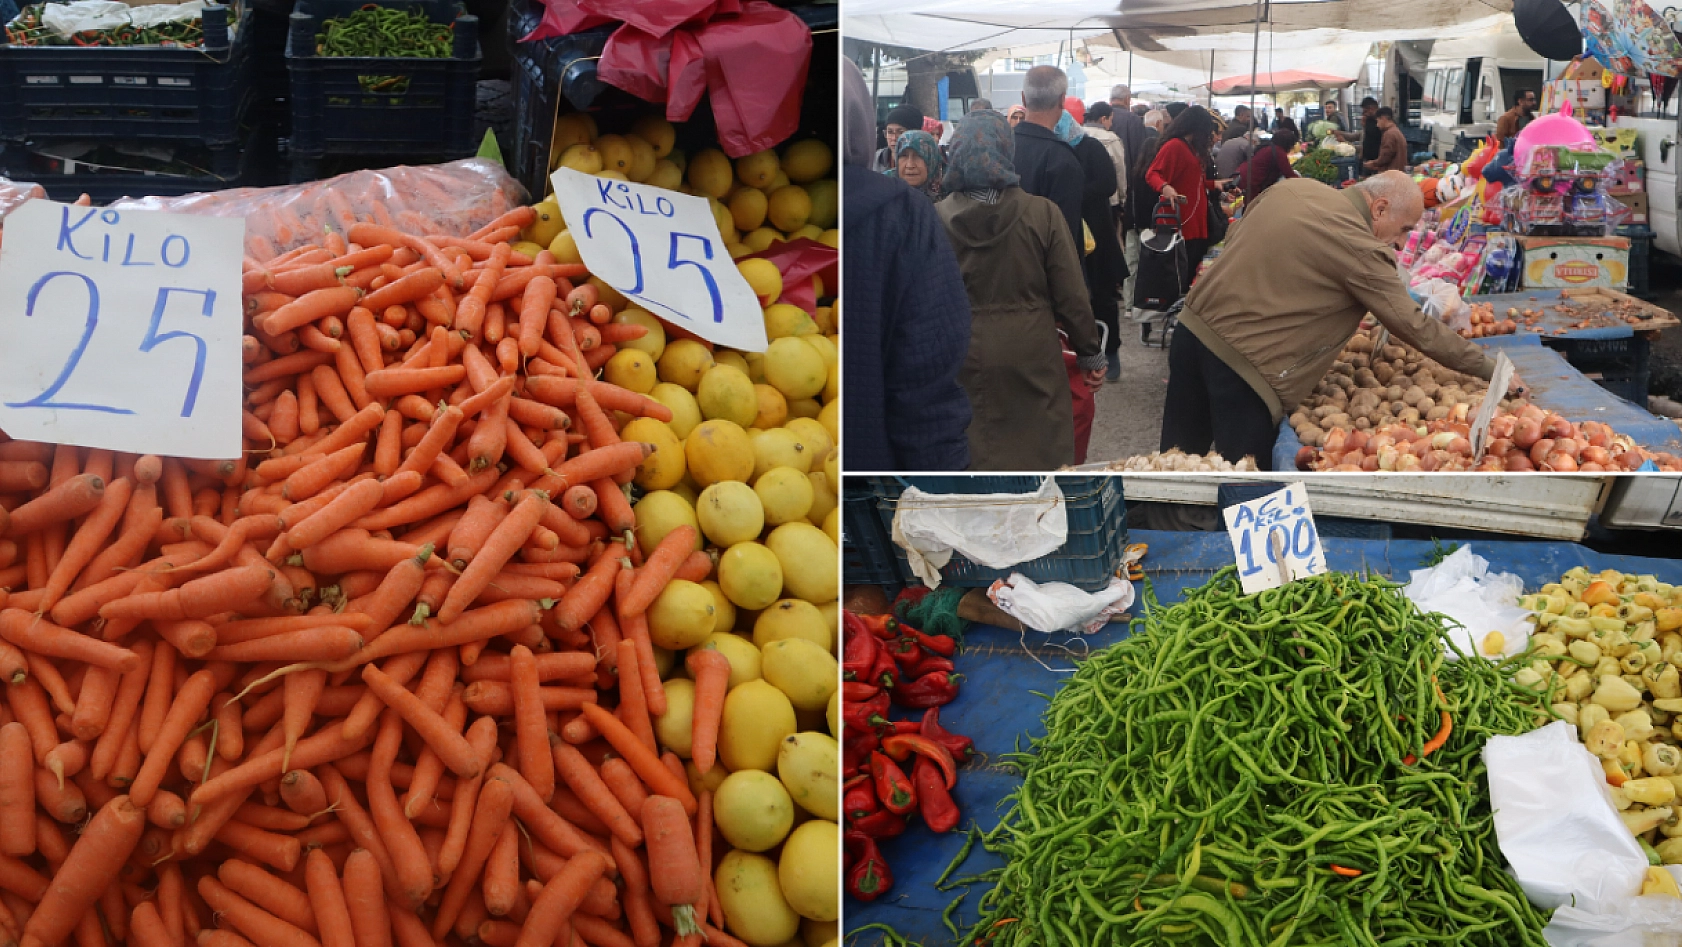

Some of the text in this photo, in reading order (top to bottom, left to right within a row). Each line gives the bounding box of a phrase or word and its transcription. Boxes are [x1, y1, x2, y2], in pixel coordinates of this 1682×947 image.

[583, 207, 724, 323] 25
[4, 271, 217, 418] 25
[1239, 517, 1317, 577] 100
